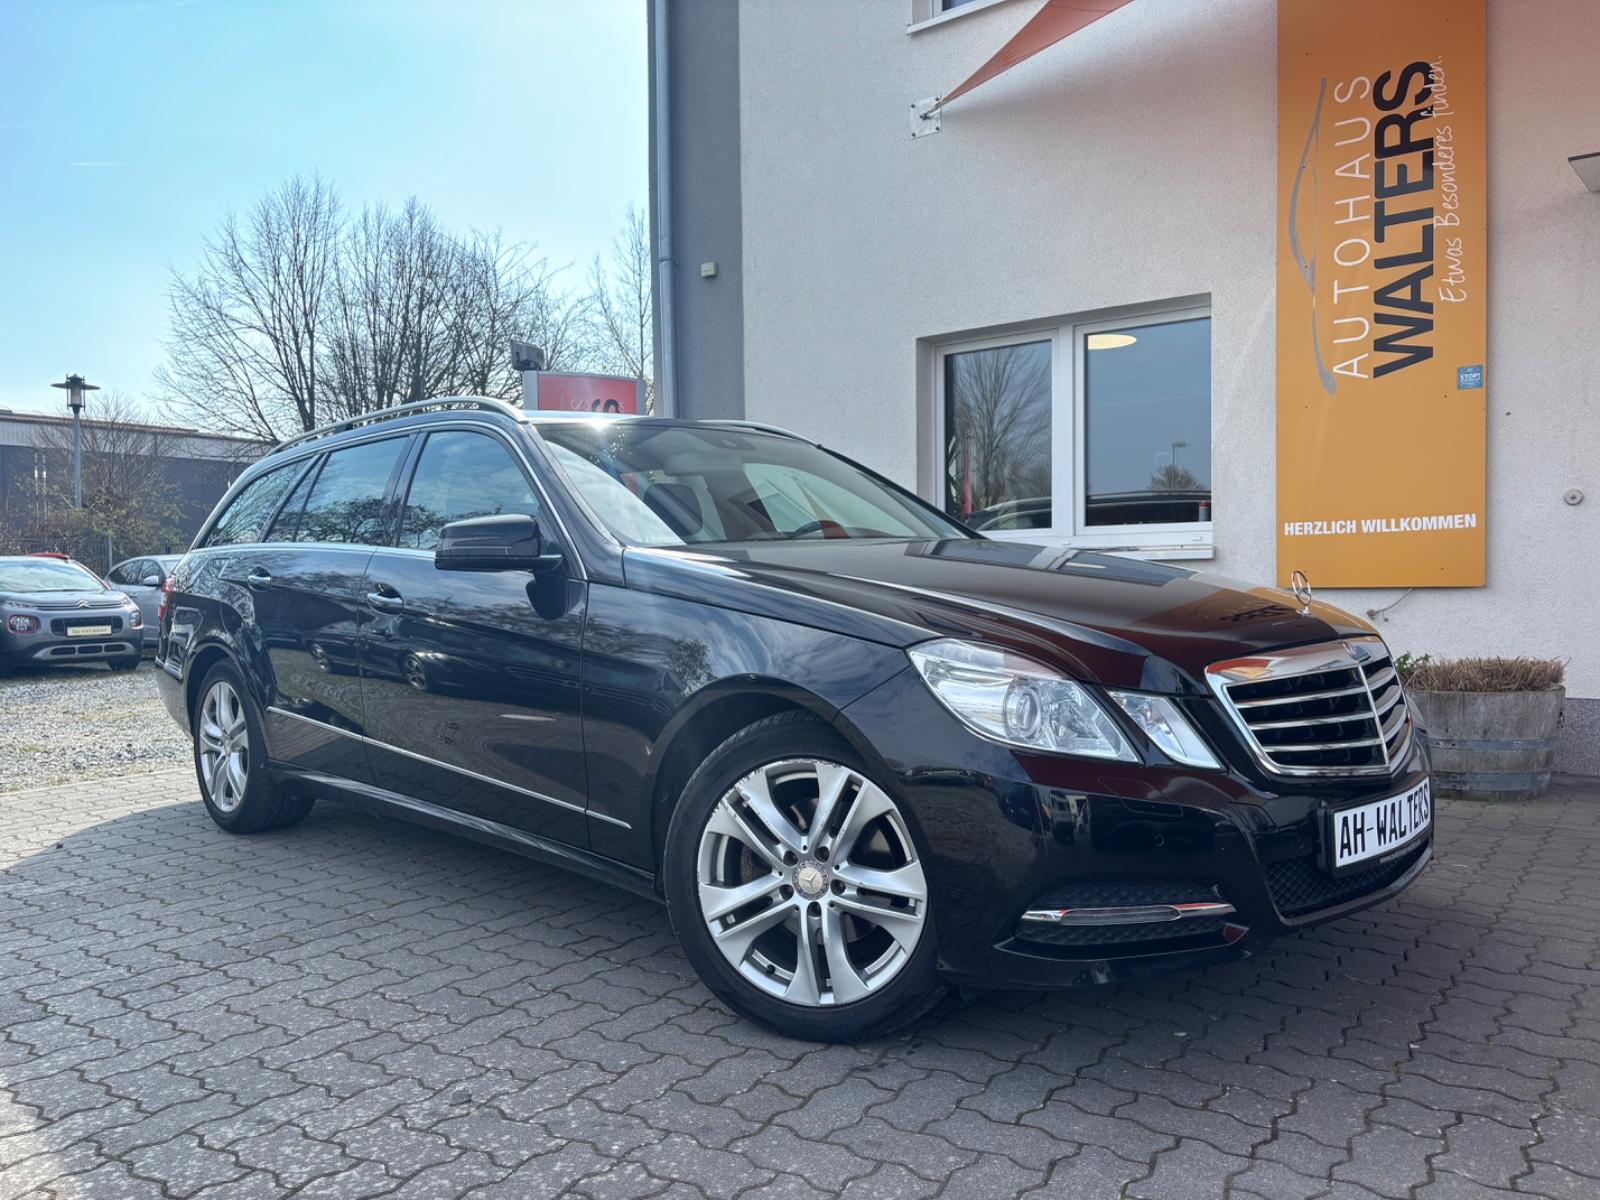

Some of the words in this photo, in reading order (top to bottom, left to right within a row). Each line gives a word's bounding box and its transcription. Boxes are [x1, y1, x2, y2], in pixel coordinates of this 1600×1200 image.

[1373, 61, 1434, 379] WALTERS
[1432, 125, 1460, 229] Besonderes
[1333, 76, 1371, 379] AUTOHAUS
[1439, 237, 1467, 303] Etwas
[1284, 520, 1357, 536] HERZLICH
[1361, 513, 1477, 534] WILLKOMMEN
[1340, 783, 1429, 858] AH-WALTERS
